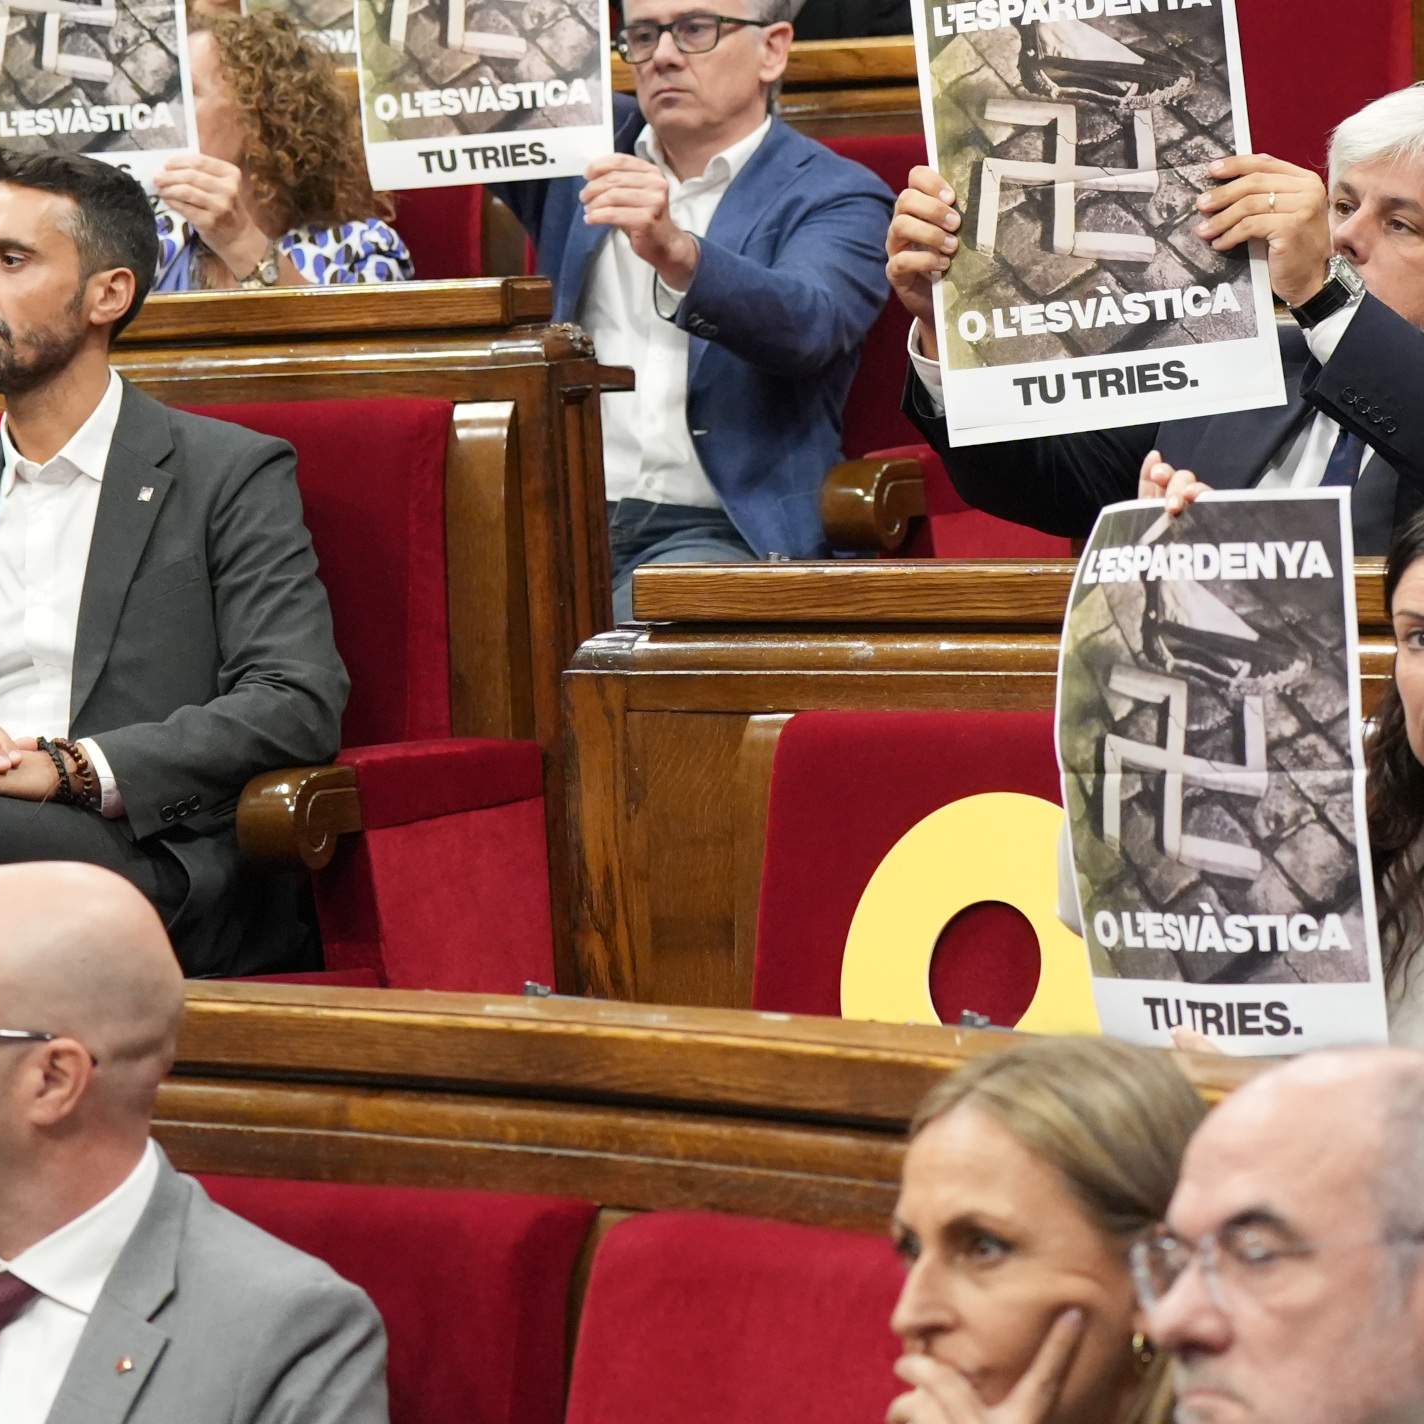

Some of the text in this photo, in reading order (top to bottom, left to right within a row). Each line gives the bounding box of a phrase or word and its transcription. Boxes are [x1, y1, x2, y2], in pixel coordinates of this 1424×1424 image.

[0, 100, 175, 138] L'ESVÀSTICA
[375, 79, 592, 121] O L'ESVÀSTICA
[418, 142, 555, 174] TU TRIES.
[958, 282, 1241, 343] O L'ESVÀSTICA
[1013, 360, 1198, 407] TU TRIES.
[1082, 540, 1334, 586] L'ESPARDENYA
[1093, 902, 1352, 954] O L'ESVÀSTICA
[1143, 997, 1303, 1036] TU TRIES.
